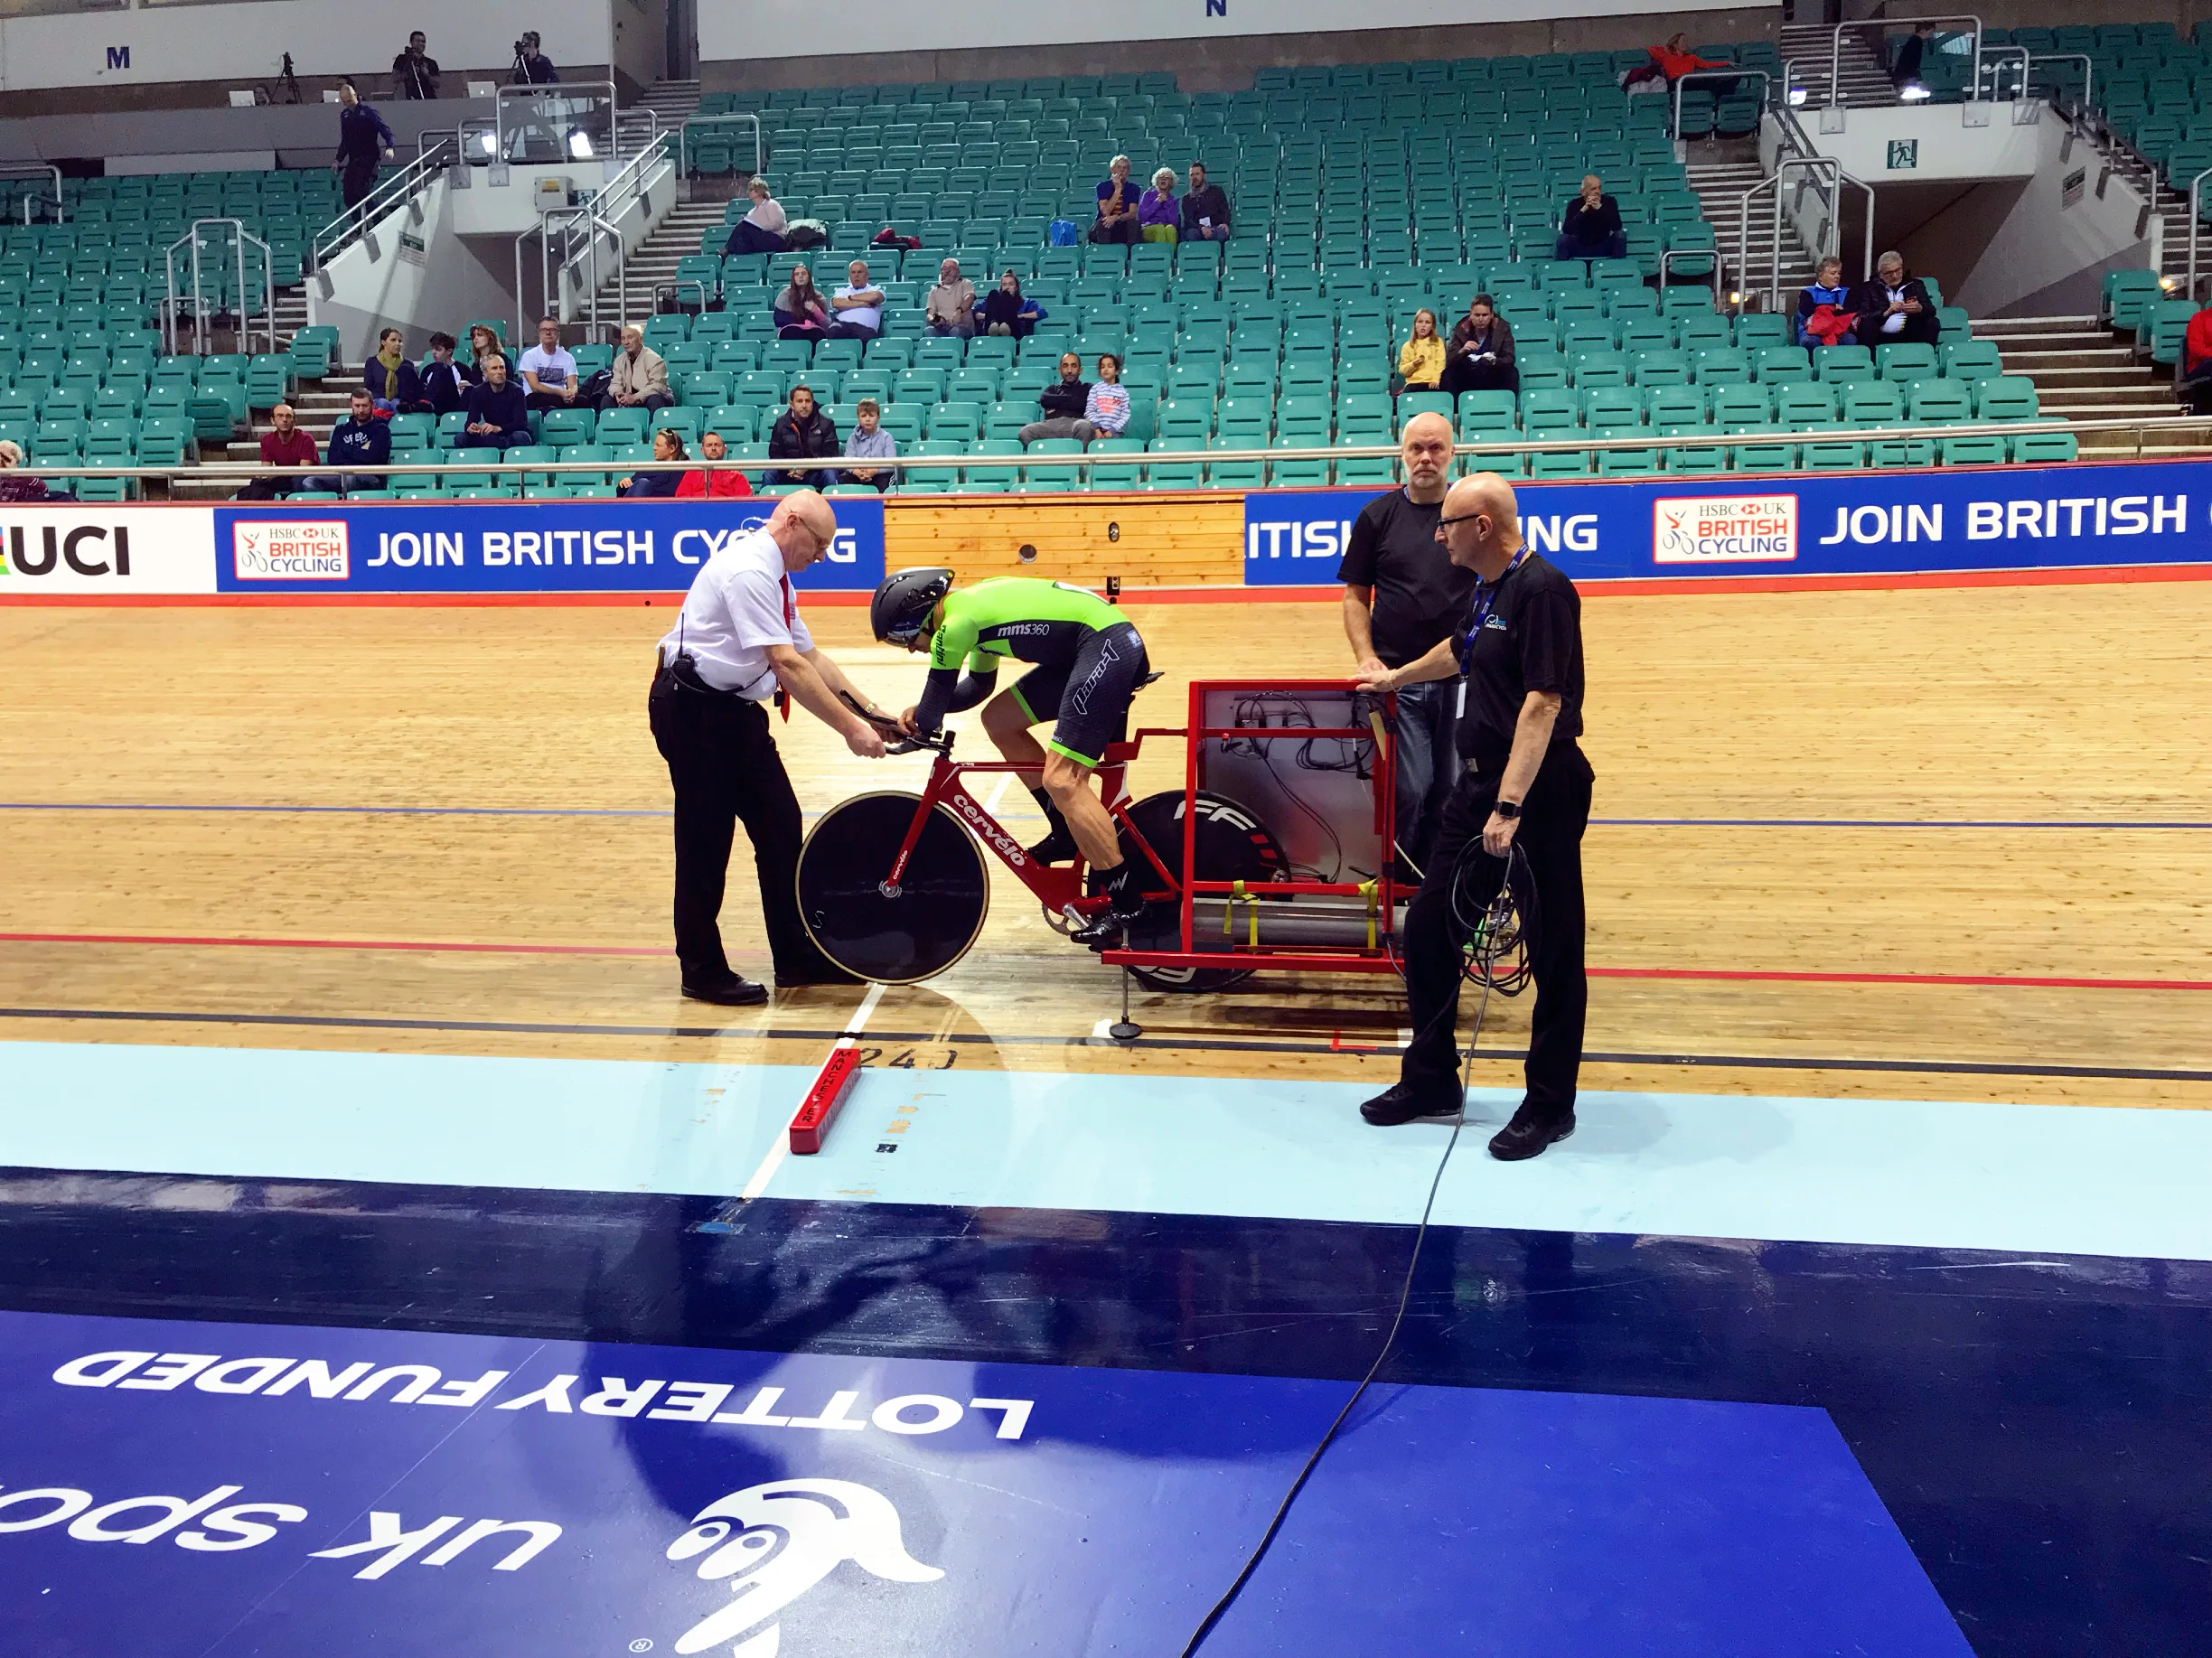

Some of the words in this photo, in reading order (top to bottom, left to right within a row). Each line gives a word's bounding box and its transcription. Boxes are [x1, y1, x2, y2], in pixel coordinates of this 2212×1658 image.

[1206, 0, 1227, 17] N
[107, 46, 130, 70] M
[1699, 504, 1739, 517] HSBC
[1764, 503, 1786, 514] UK
[1819, 503, 1944, 545] JOIN
[1966, 494, 2188, 540] BRITISH
[269, 528, 301, 539] HSBC
[321, 528, 340, 539] UK
[1244, 520, 1352, 558] ITIS
[1698, 519, 1787, 537] BRITISH
[10, 525, 130, 576] UCI
[269, 542, 342, 557] BRITISH
[367, 531, 464, 567] JOIN
[483, 529, 654, 567] BRITISH
[1698, 537, 1786, 554] CYCLING
[270, 558, 342, 572] CYCLING
[997, 623, 1050, 637] mms360
[52, 1350, 511, 1408] FUNDED
[493, 1374, 1036, 1440] LOTTERY
[0, 1485, 309, 1552] spo
[307, 1511, 564, 1580] uk
